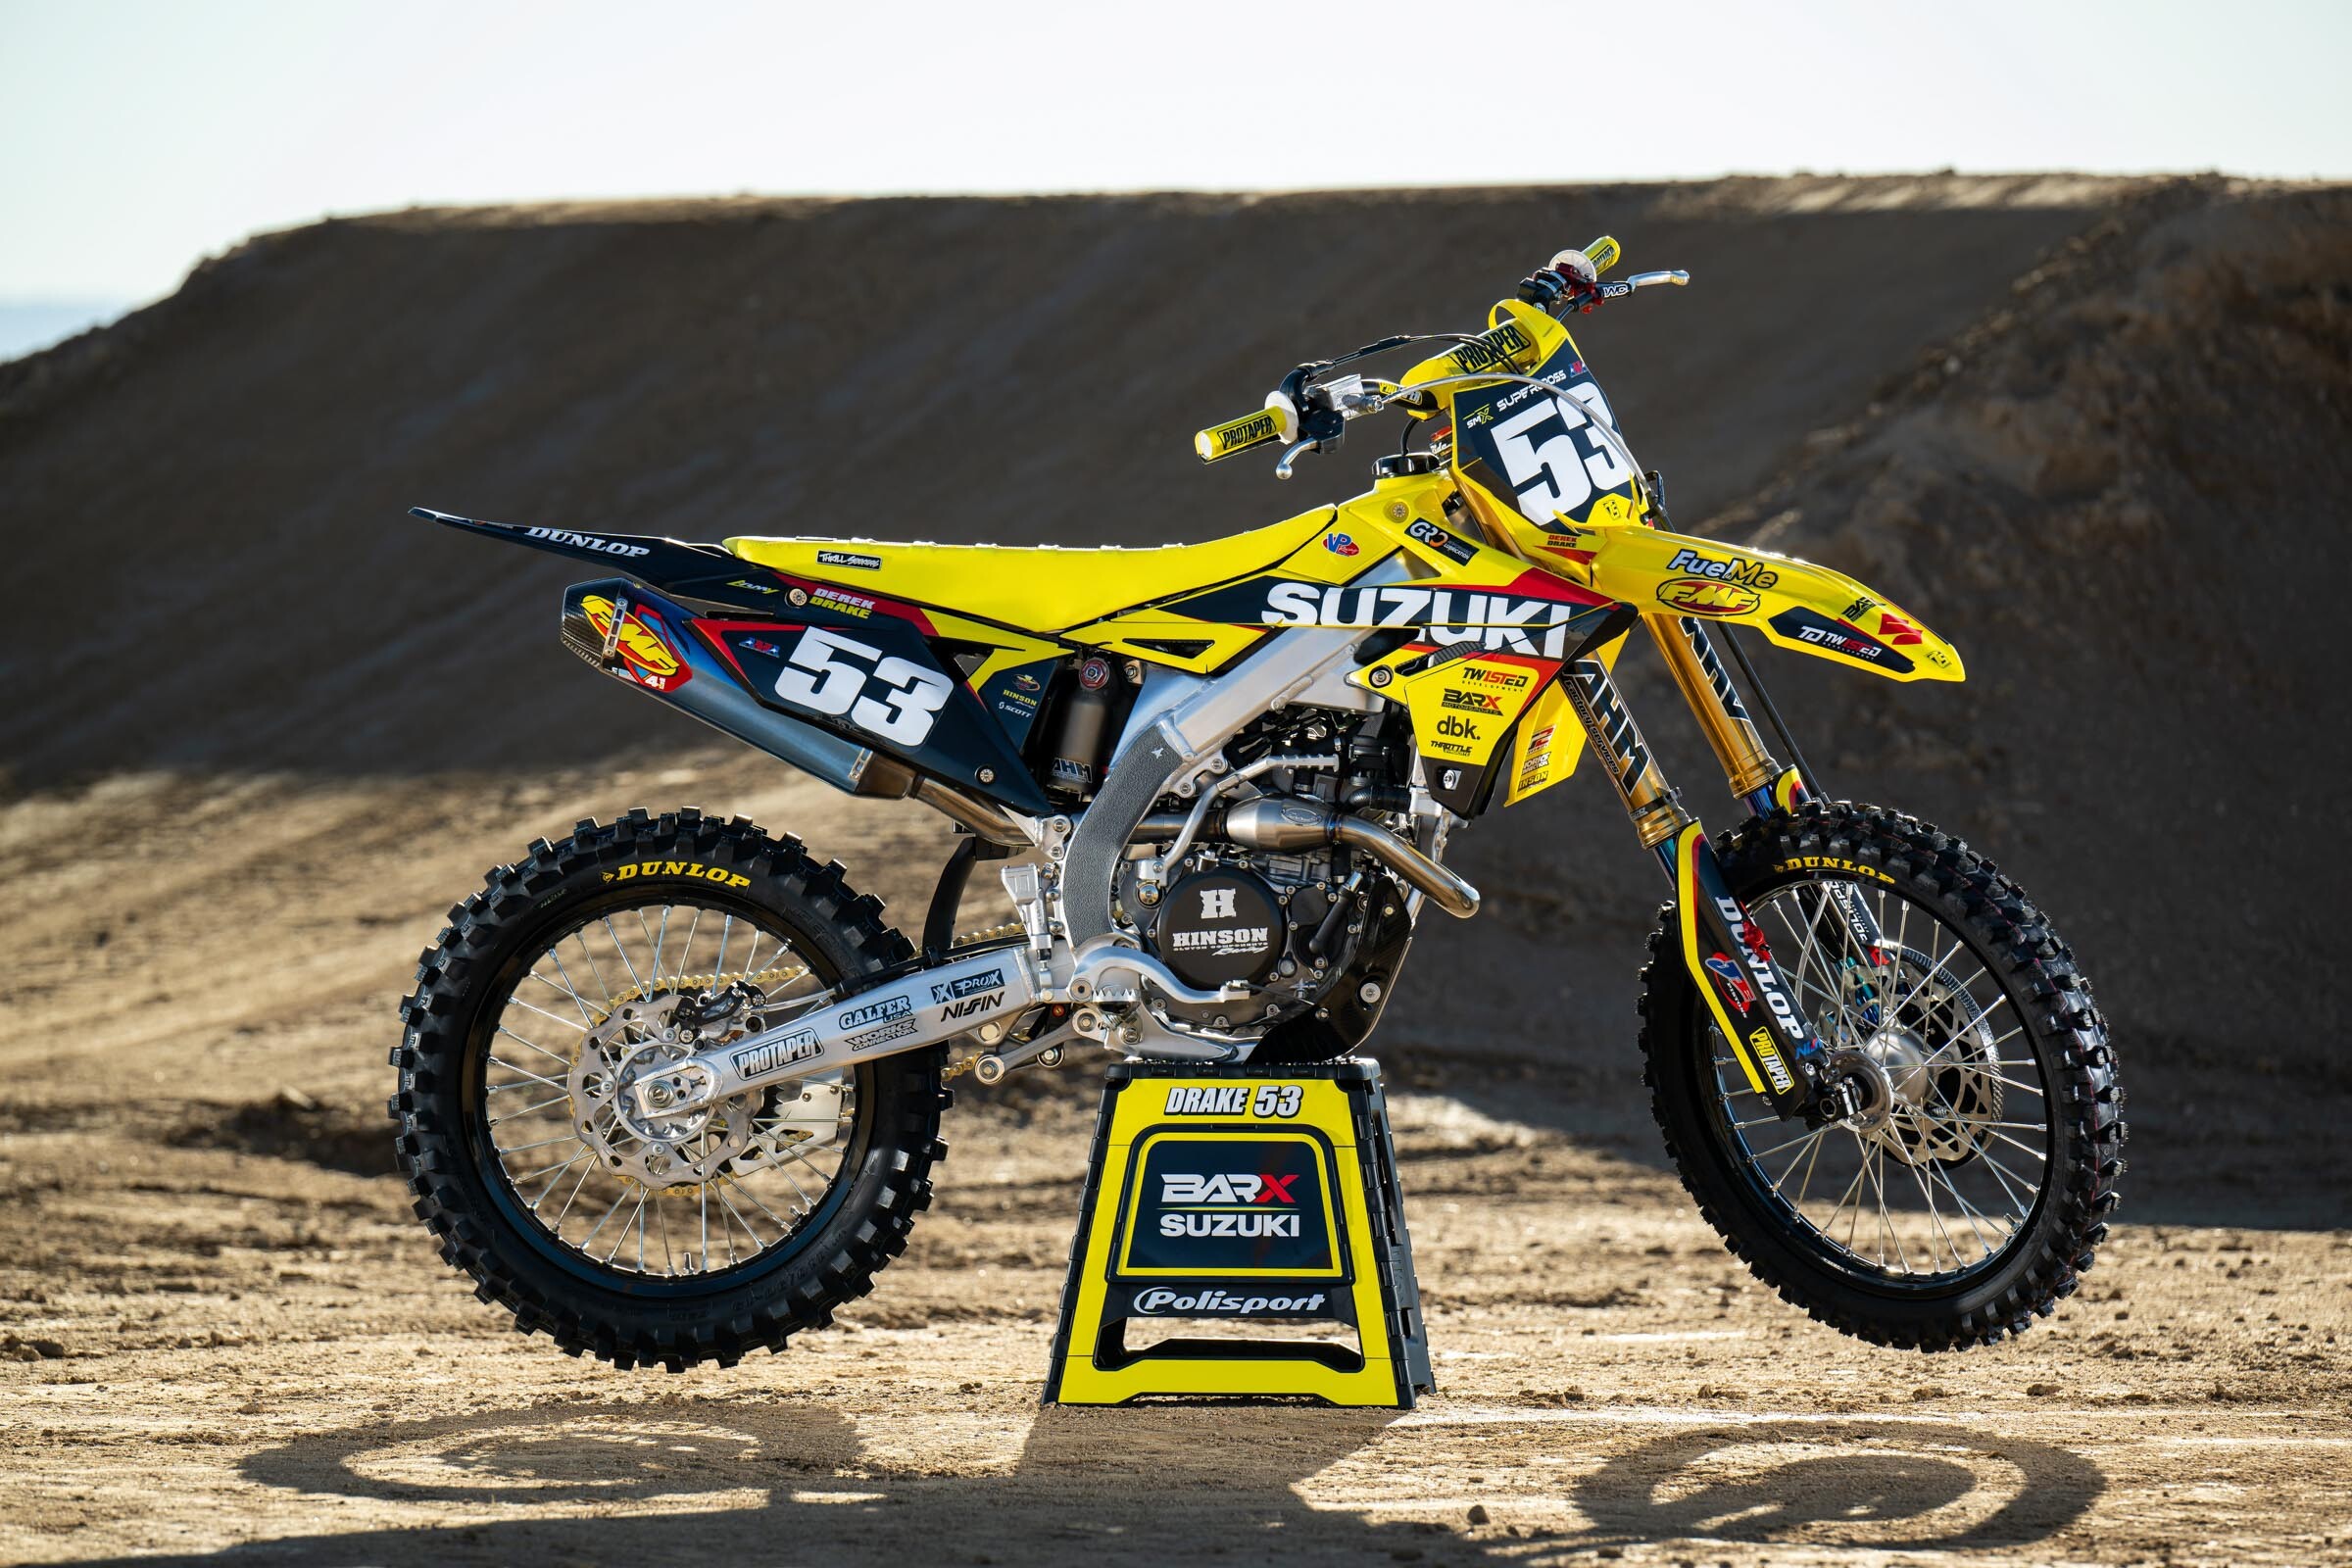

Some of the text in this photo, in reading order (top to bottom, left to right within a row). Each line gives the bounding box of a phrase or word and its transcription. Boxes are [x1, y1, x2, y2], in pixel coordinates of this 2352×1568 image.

[1222, 416, 1274, 450] PROTAPER
[1490, 382, 1636, 526] 53
[524, 526, 651, 557] DUNLOP
[1327, 532, 1352, 553] VP
[1409, 521, 1449, 548] GRO
[1667, 549, 1779, 588] FuelMe
[809, 597, 872, 619] DRAKE
[812, 588, 876, 610] DEREK
[1657, 583, 1761, 610] FMF
[1261, 582, 1571, 660] SUZUKI
[774, 625, 955, 747] 53
[1003, 689, 1038, 707] HINSON
[1442, 688, 1503, 710] BARX
[1004, 705, 1032, 717] SCOTT
[1430, 740, 1473, 754] THROTTLE
[615, 861, 752, 887] DUNLOP
[1785, 857, 1895, 884] DUNLOP
[1200, 888, 1237, 919] H
[1172, 927, 1268, 948] HINSON
[840, 997, 911, 1029] GALFER
[884, 1010, 914, 1023] USA
[940, 991, 1005, 1022] NISSIN
[847, 1020, 915, 1045] WORKS
[853, 1027, 917, 1051] CONNECTION
[738, 1031, 818, 1077] PROTAPER
[1752, 1031, 1791, 1090] PROTAPER
[1164, 1085, 1303, 1118] DRAKE 53
[1160, 1174, 1300, 1203] BARX
[1159, 1213, 1300, 1238] SUZUKI
[1143, 1289, 1326, 1314] Polisport
